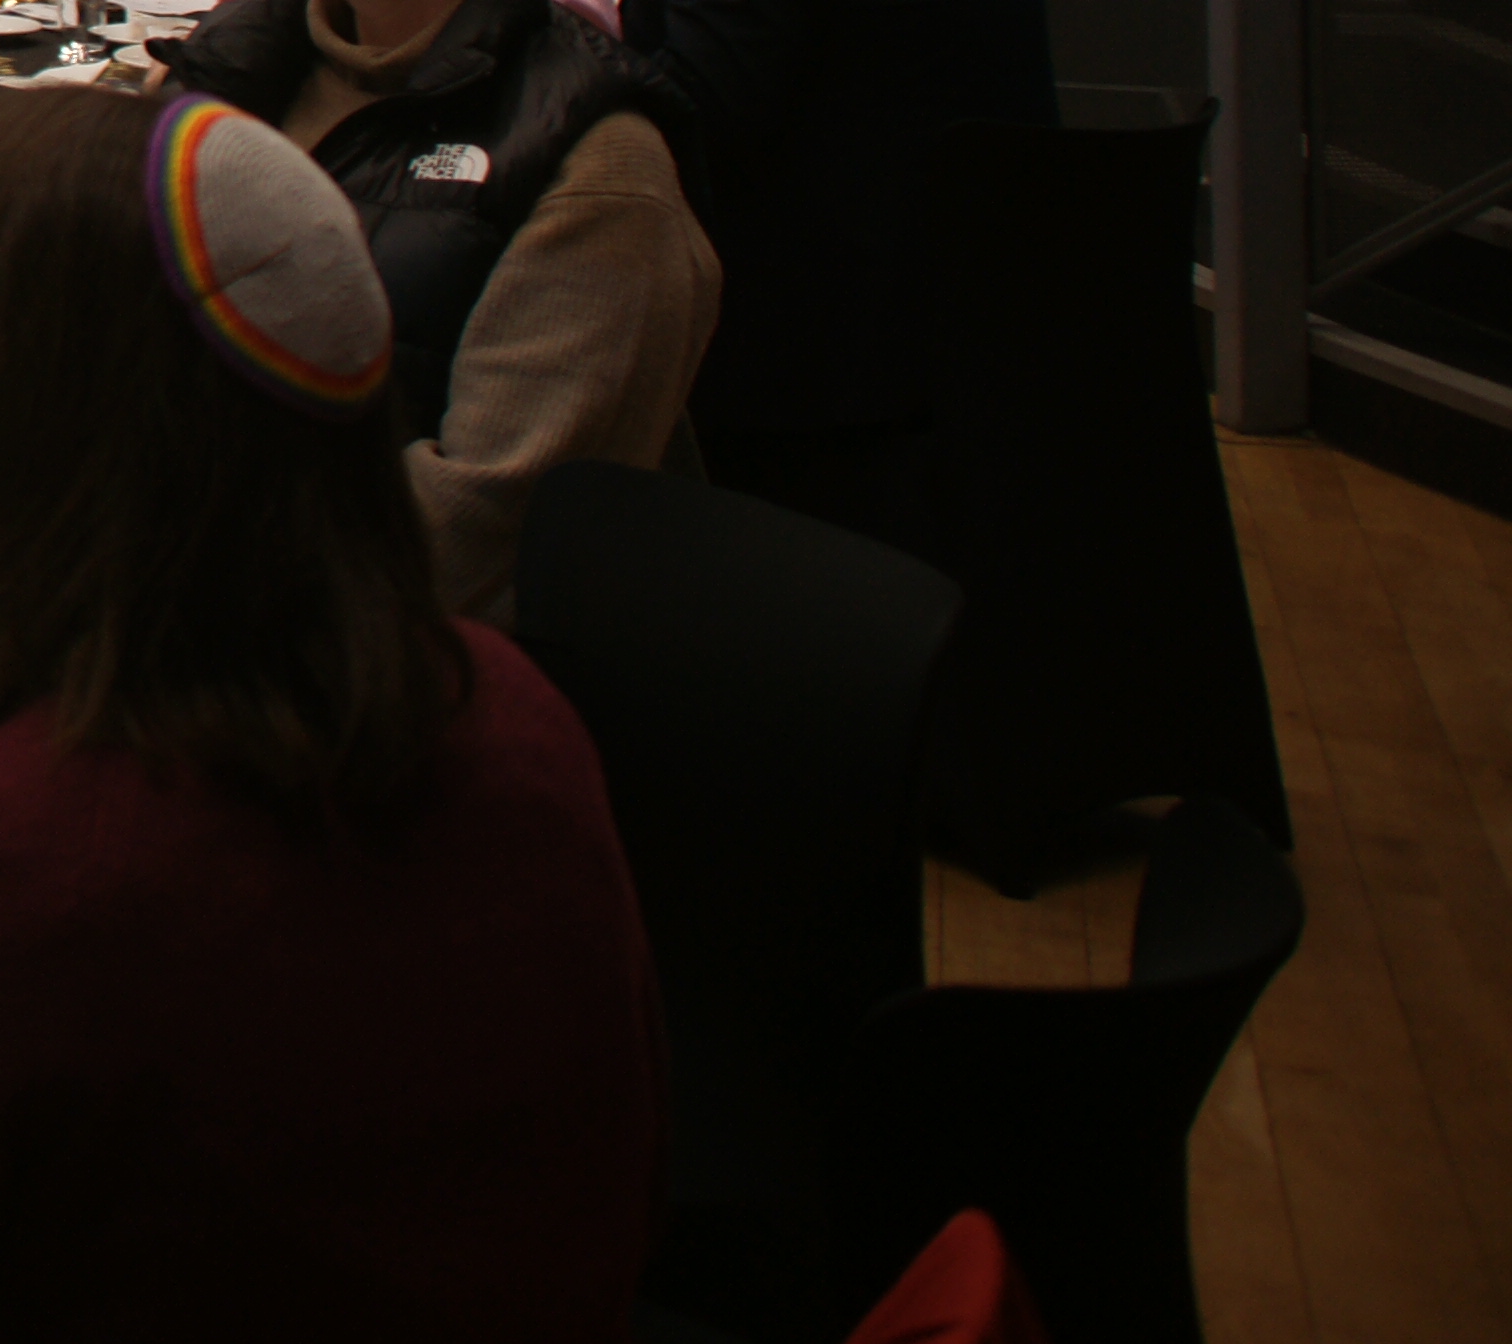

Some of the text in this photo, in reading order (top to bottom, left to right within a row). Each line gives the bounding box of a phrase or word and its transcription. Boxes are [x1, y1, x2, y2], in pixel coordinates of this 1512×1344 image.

[434, 143, 465, 155] THE
[407, 155, 458, 172] NORTH
[414, 166, 455, 180] FACE
